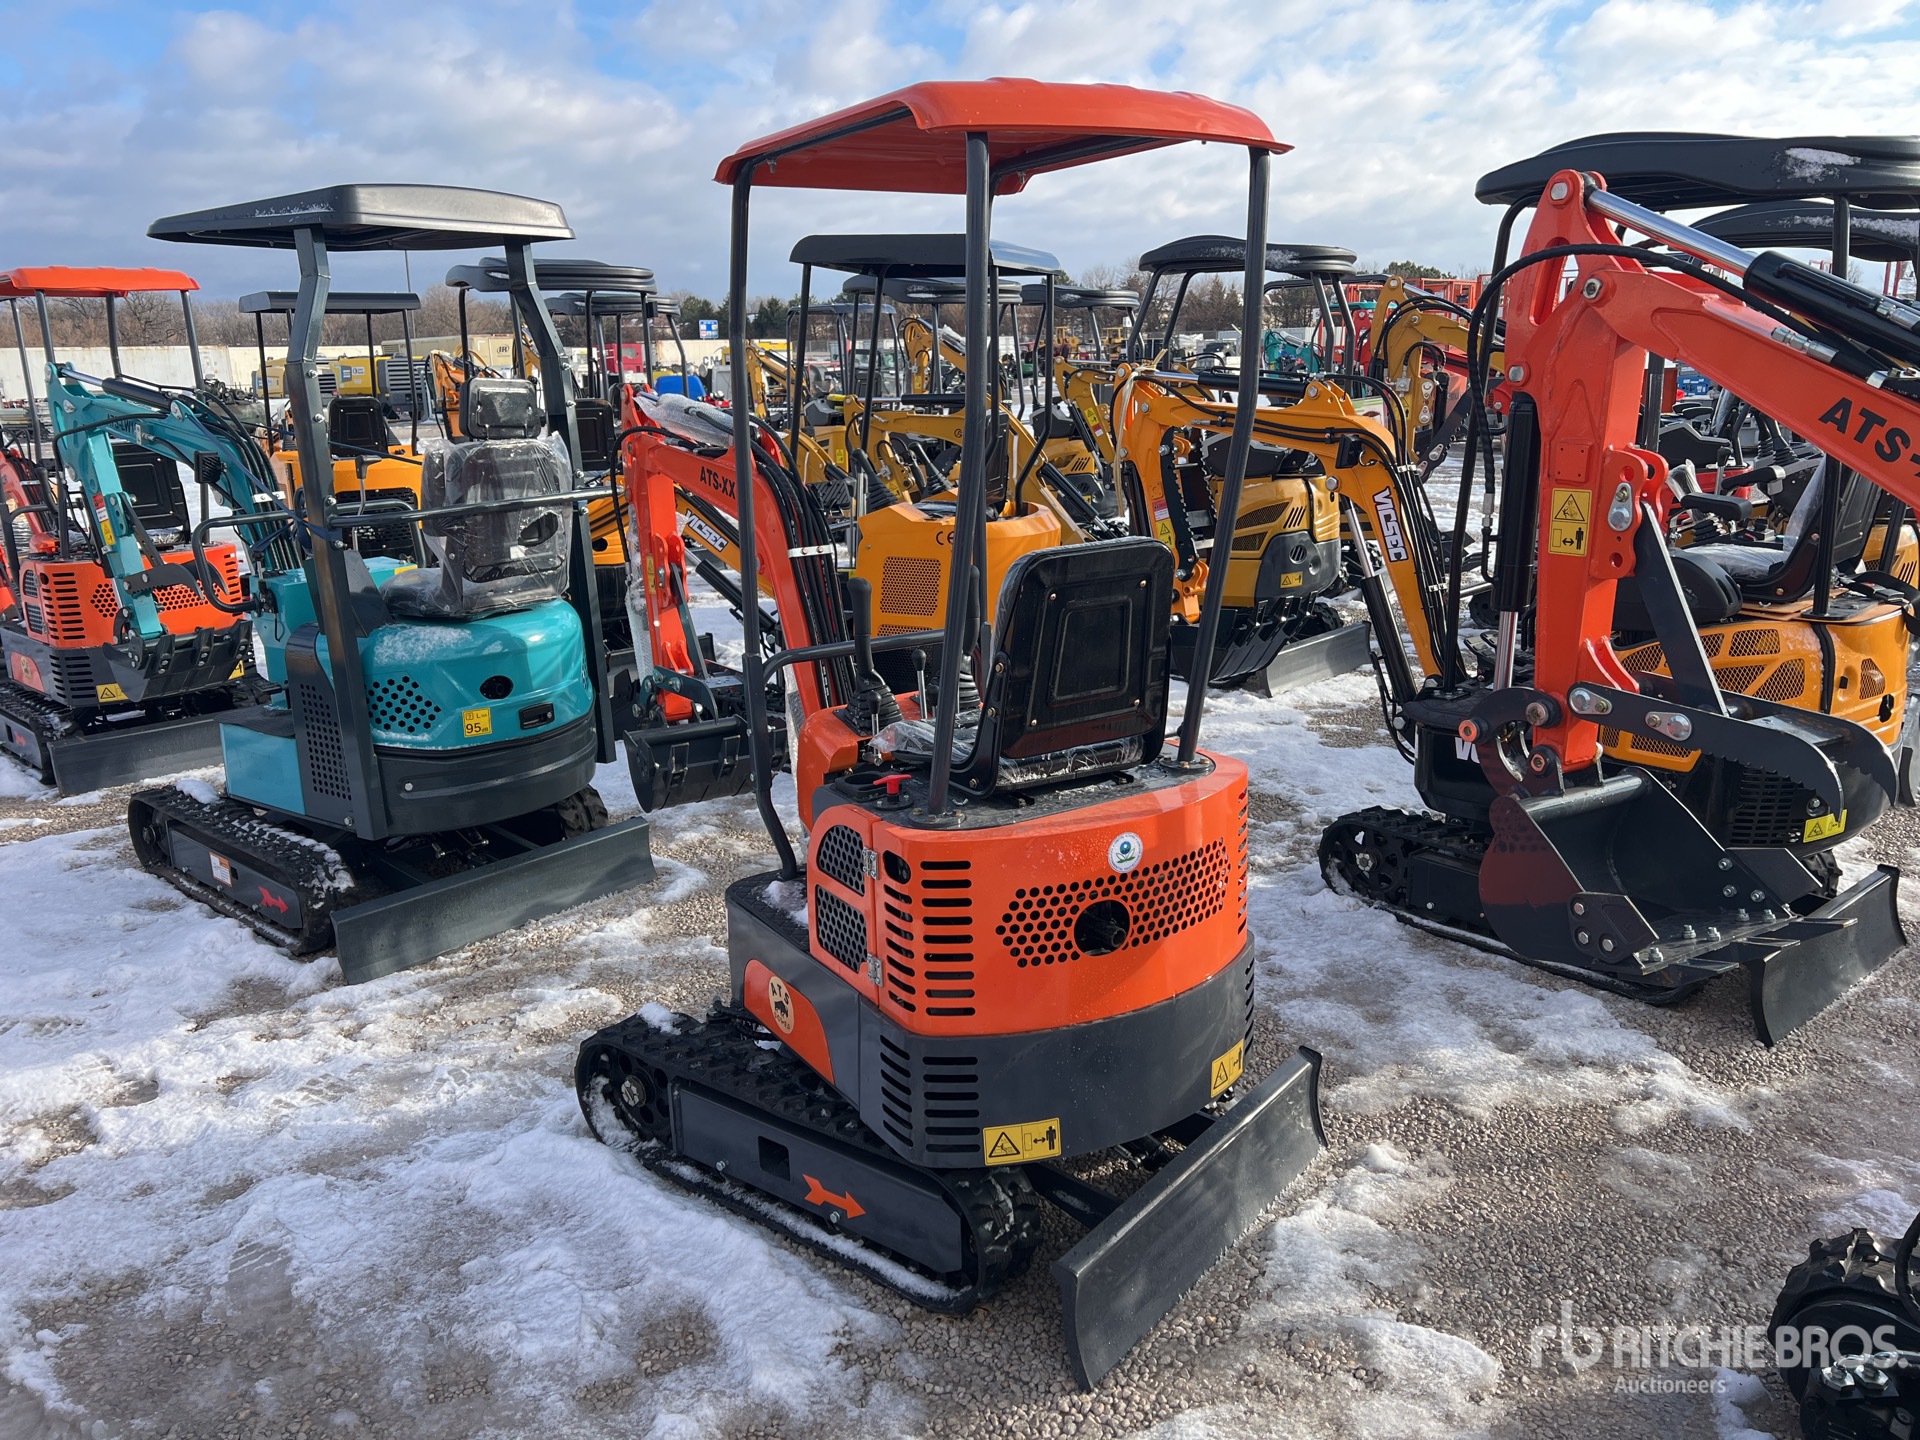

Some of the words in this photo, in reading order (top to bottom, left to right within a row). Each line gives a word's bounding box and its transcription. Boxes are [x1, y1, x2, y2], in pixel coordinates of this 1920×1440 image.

[1818, 397, 1920, 478] ATS-
[700, 466, 736, 499] ATS-XX
[466, 723, 481, 734] 95
[770, 982, 790, 1005] ATS
